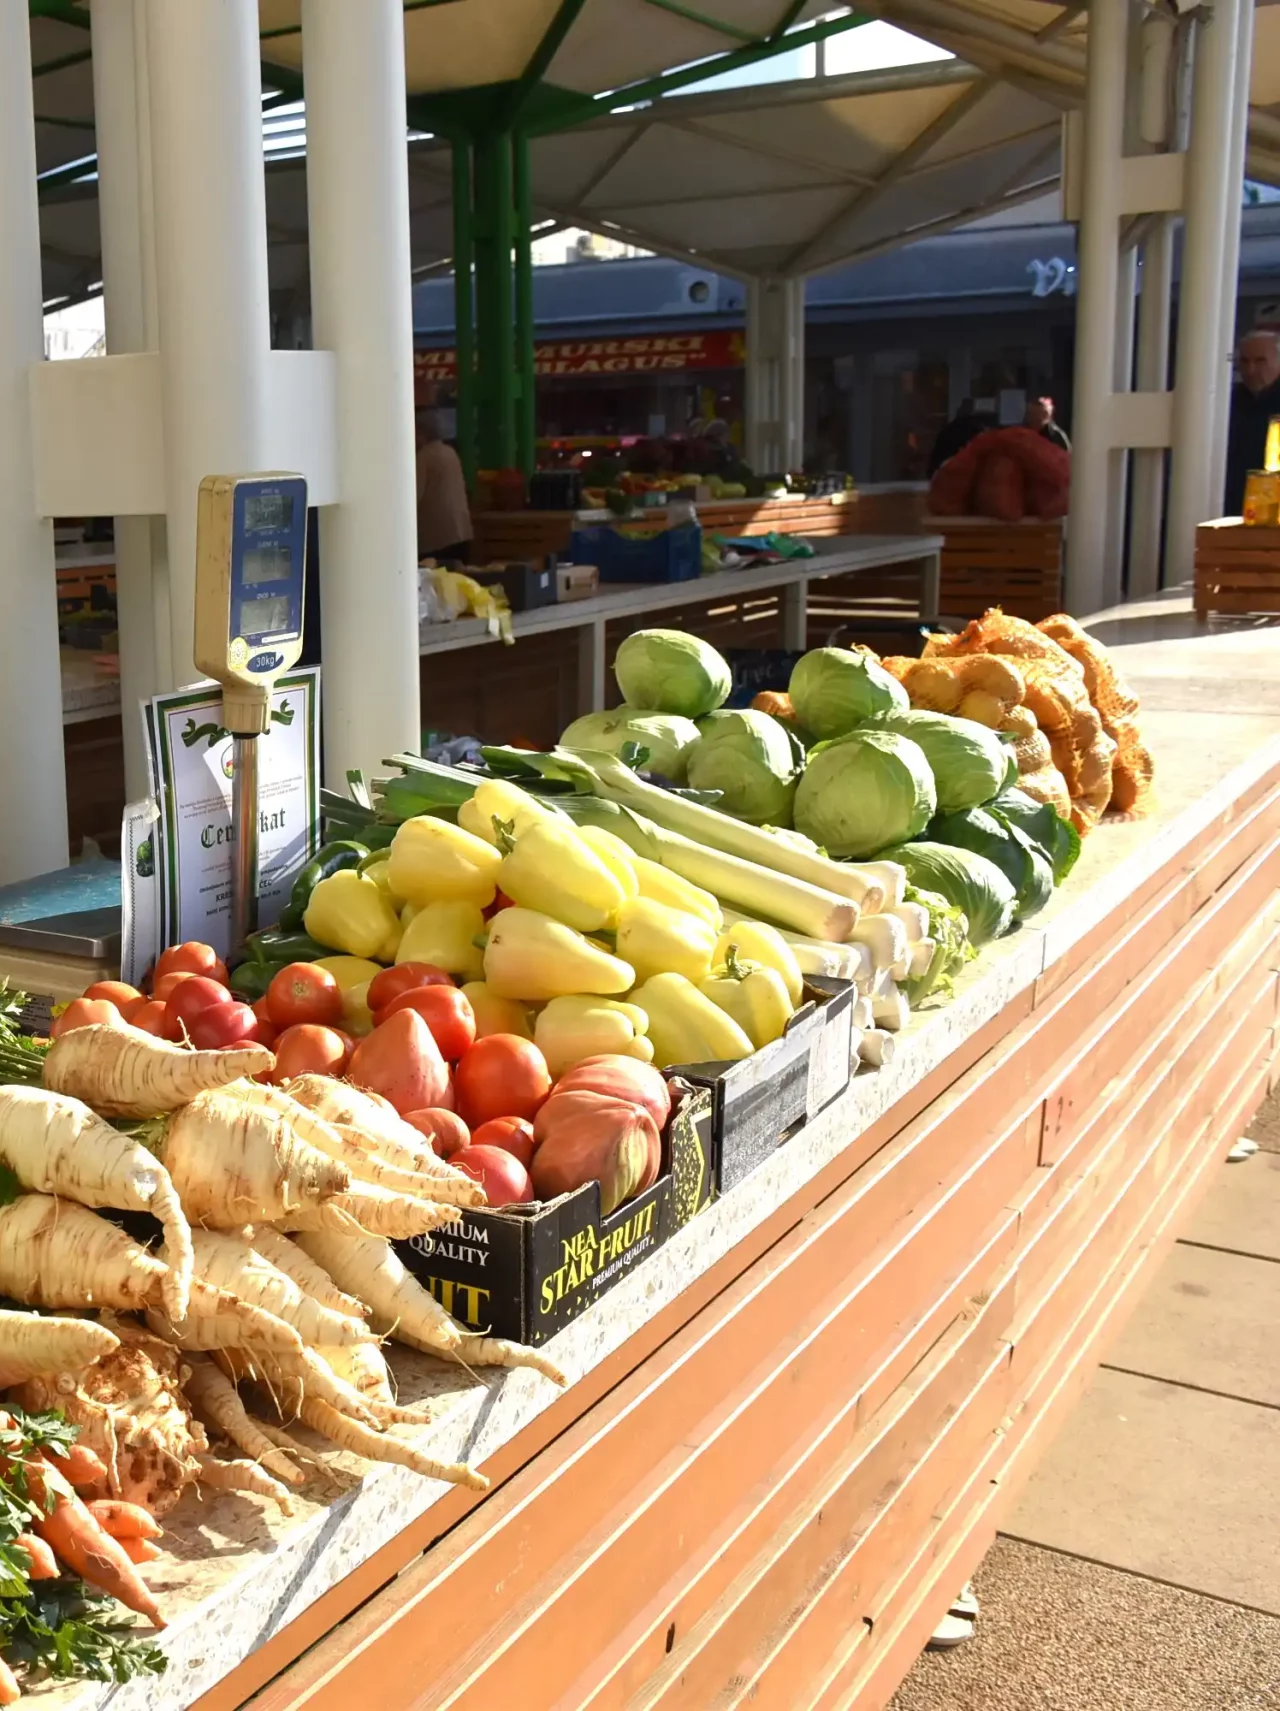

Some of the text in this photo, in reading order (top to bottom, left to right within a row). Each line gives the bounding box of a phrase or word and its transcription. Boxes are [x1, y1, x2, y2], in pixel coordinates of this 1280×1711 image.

[256, 654, 275, 668] 30kg
[435, 1219, 490, 1244] MIUM
[561, 1224, 599, 1264] NEA
[408, 1234, 490, 1267] QUALITY
[540, 1248, 594, 1315] STAR
[597, 1200, 657, 1270] FRUIT
[592, 1234, 651, 1290] PREMIUM QUALITY
